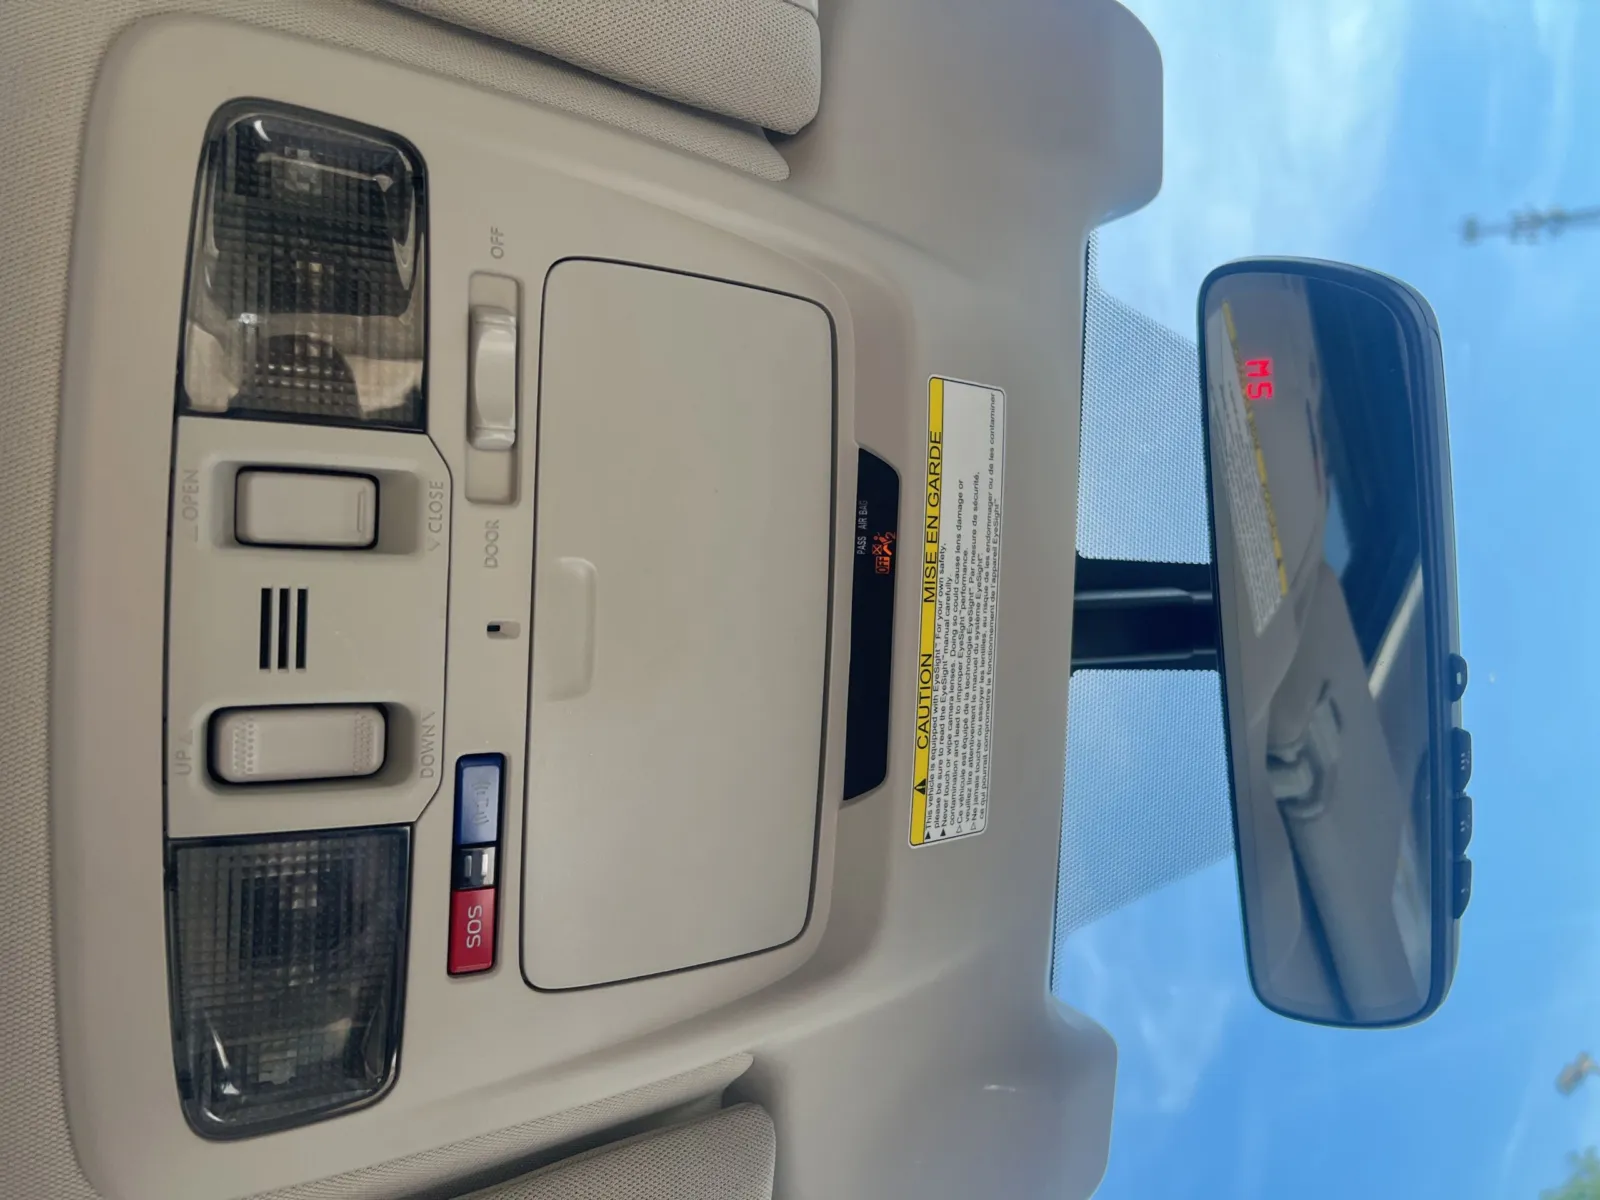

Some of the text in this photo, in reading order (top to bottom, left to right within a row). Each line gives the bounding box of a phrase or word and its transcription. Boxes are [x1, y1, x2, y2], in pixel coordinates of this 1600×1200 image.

[488, 226, 505, 259] OFF
[1246, 358, 1274, 399] SW
[182, 469, 199, 521] OPEN
[428, 480, 444, 533] CLOSE
[924, 431, 941, 602] MISE EN GARDE
[856, 500, 868, 554] PASS AIR BAG
[972, 515, 977, 526] de
[482, 519, 500, 568] DOOR
[876, 557, 888, 572] OFF
[945, 759, 950, 767] or
[953, 615, 957, 626] so
[958, 480, 963, 489] or
[917, 654, 932, 749] CAUTION
[963, 704, 969, 715] de
[964, 692, 969, 700] la
[968, 706, 976, 768] attentivement
[973, 644, 978, 654] du
[420, 724, 436, 778] DOWN
[930, 717, 938, 760] equipped
[938, 748, 943, 756] to
[175, 750, 192, 776] UP
[949, 760, 958, 825] contamination
[955, 706, 960, 714] to
[935, 783, 942, 794] be
[934, 798, 942, 828] please
[957, 810, 964, 823] Ce
[466, 905, 482, 948] SOS
